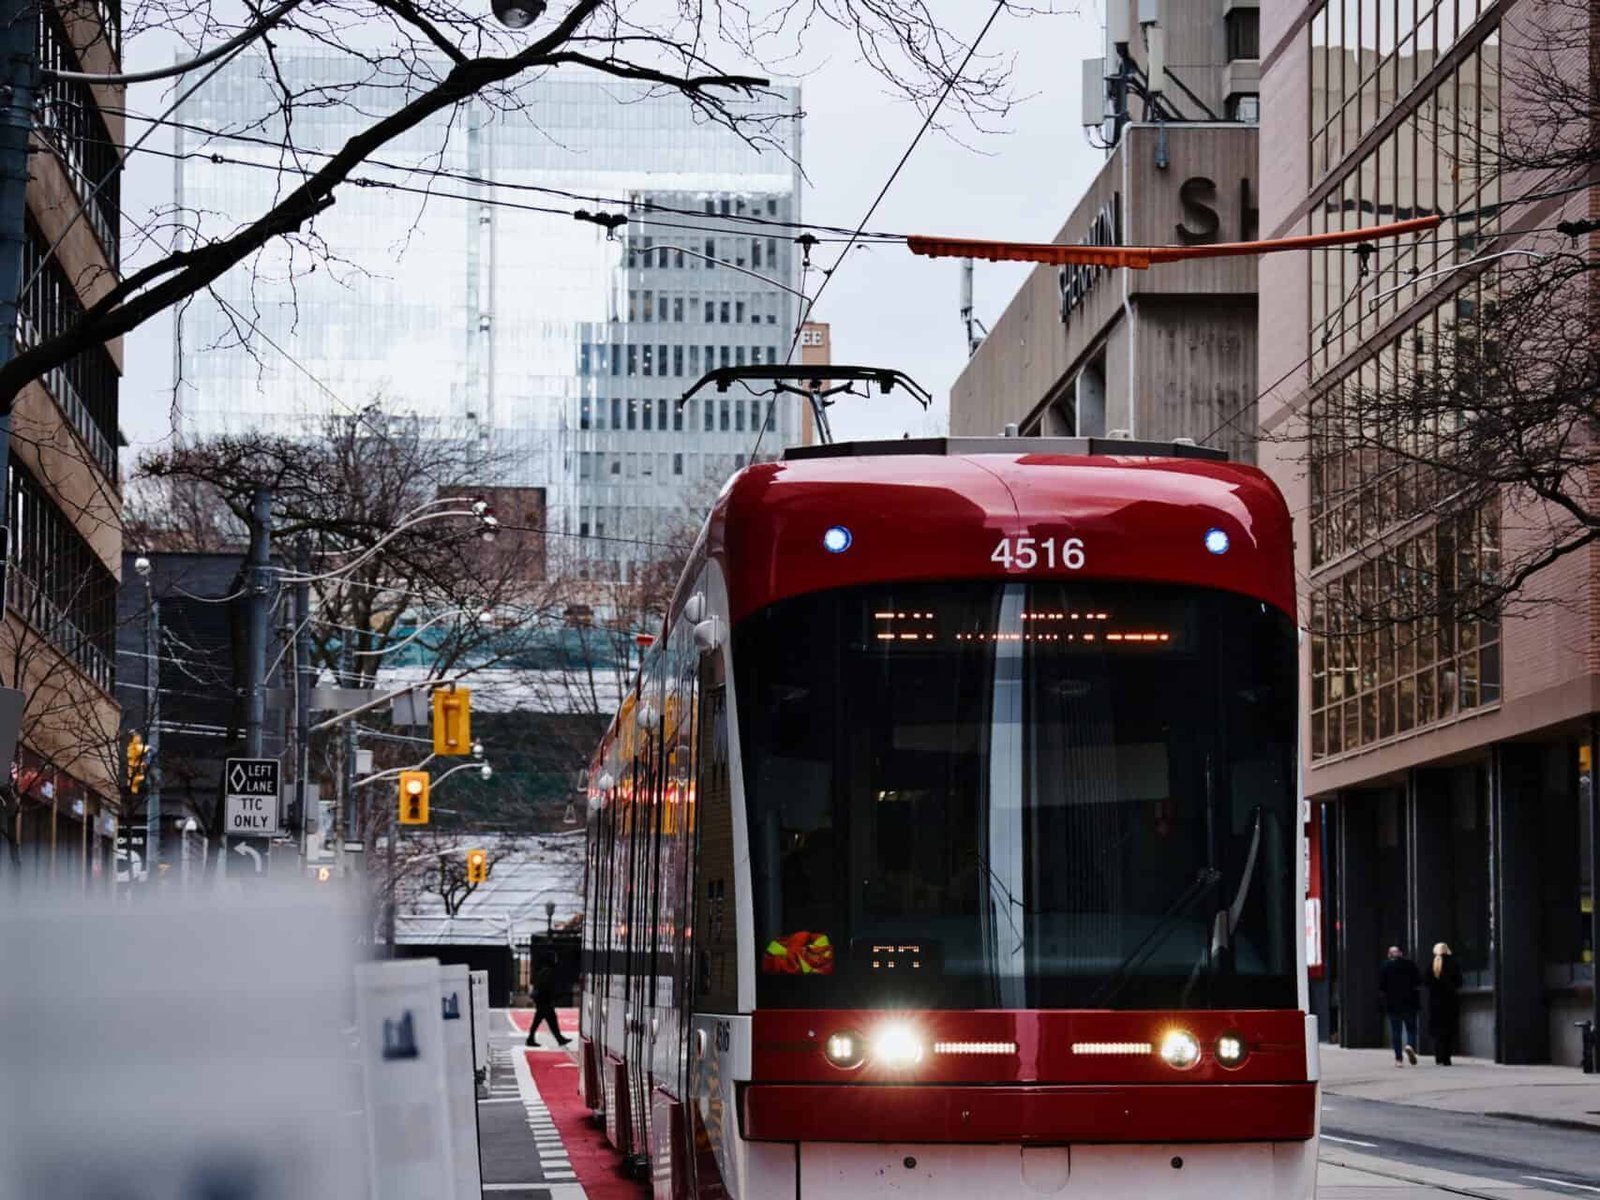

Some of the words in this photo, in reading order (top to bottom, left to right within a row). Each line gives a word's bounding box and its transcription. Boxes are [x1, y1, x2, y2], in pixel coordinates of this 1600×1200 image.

[990, 537, 1085, 569] 4516
[248, 764, 272, 777] LEFT
[246, 781, 273, 793] LANE
[241, 798, 262, 811] TTC
[234, 815, 268, 828] ONLY
